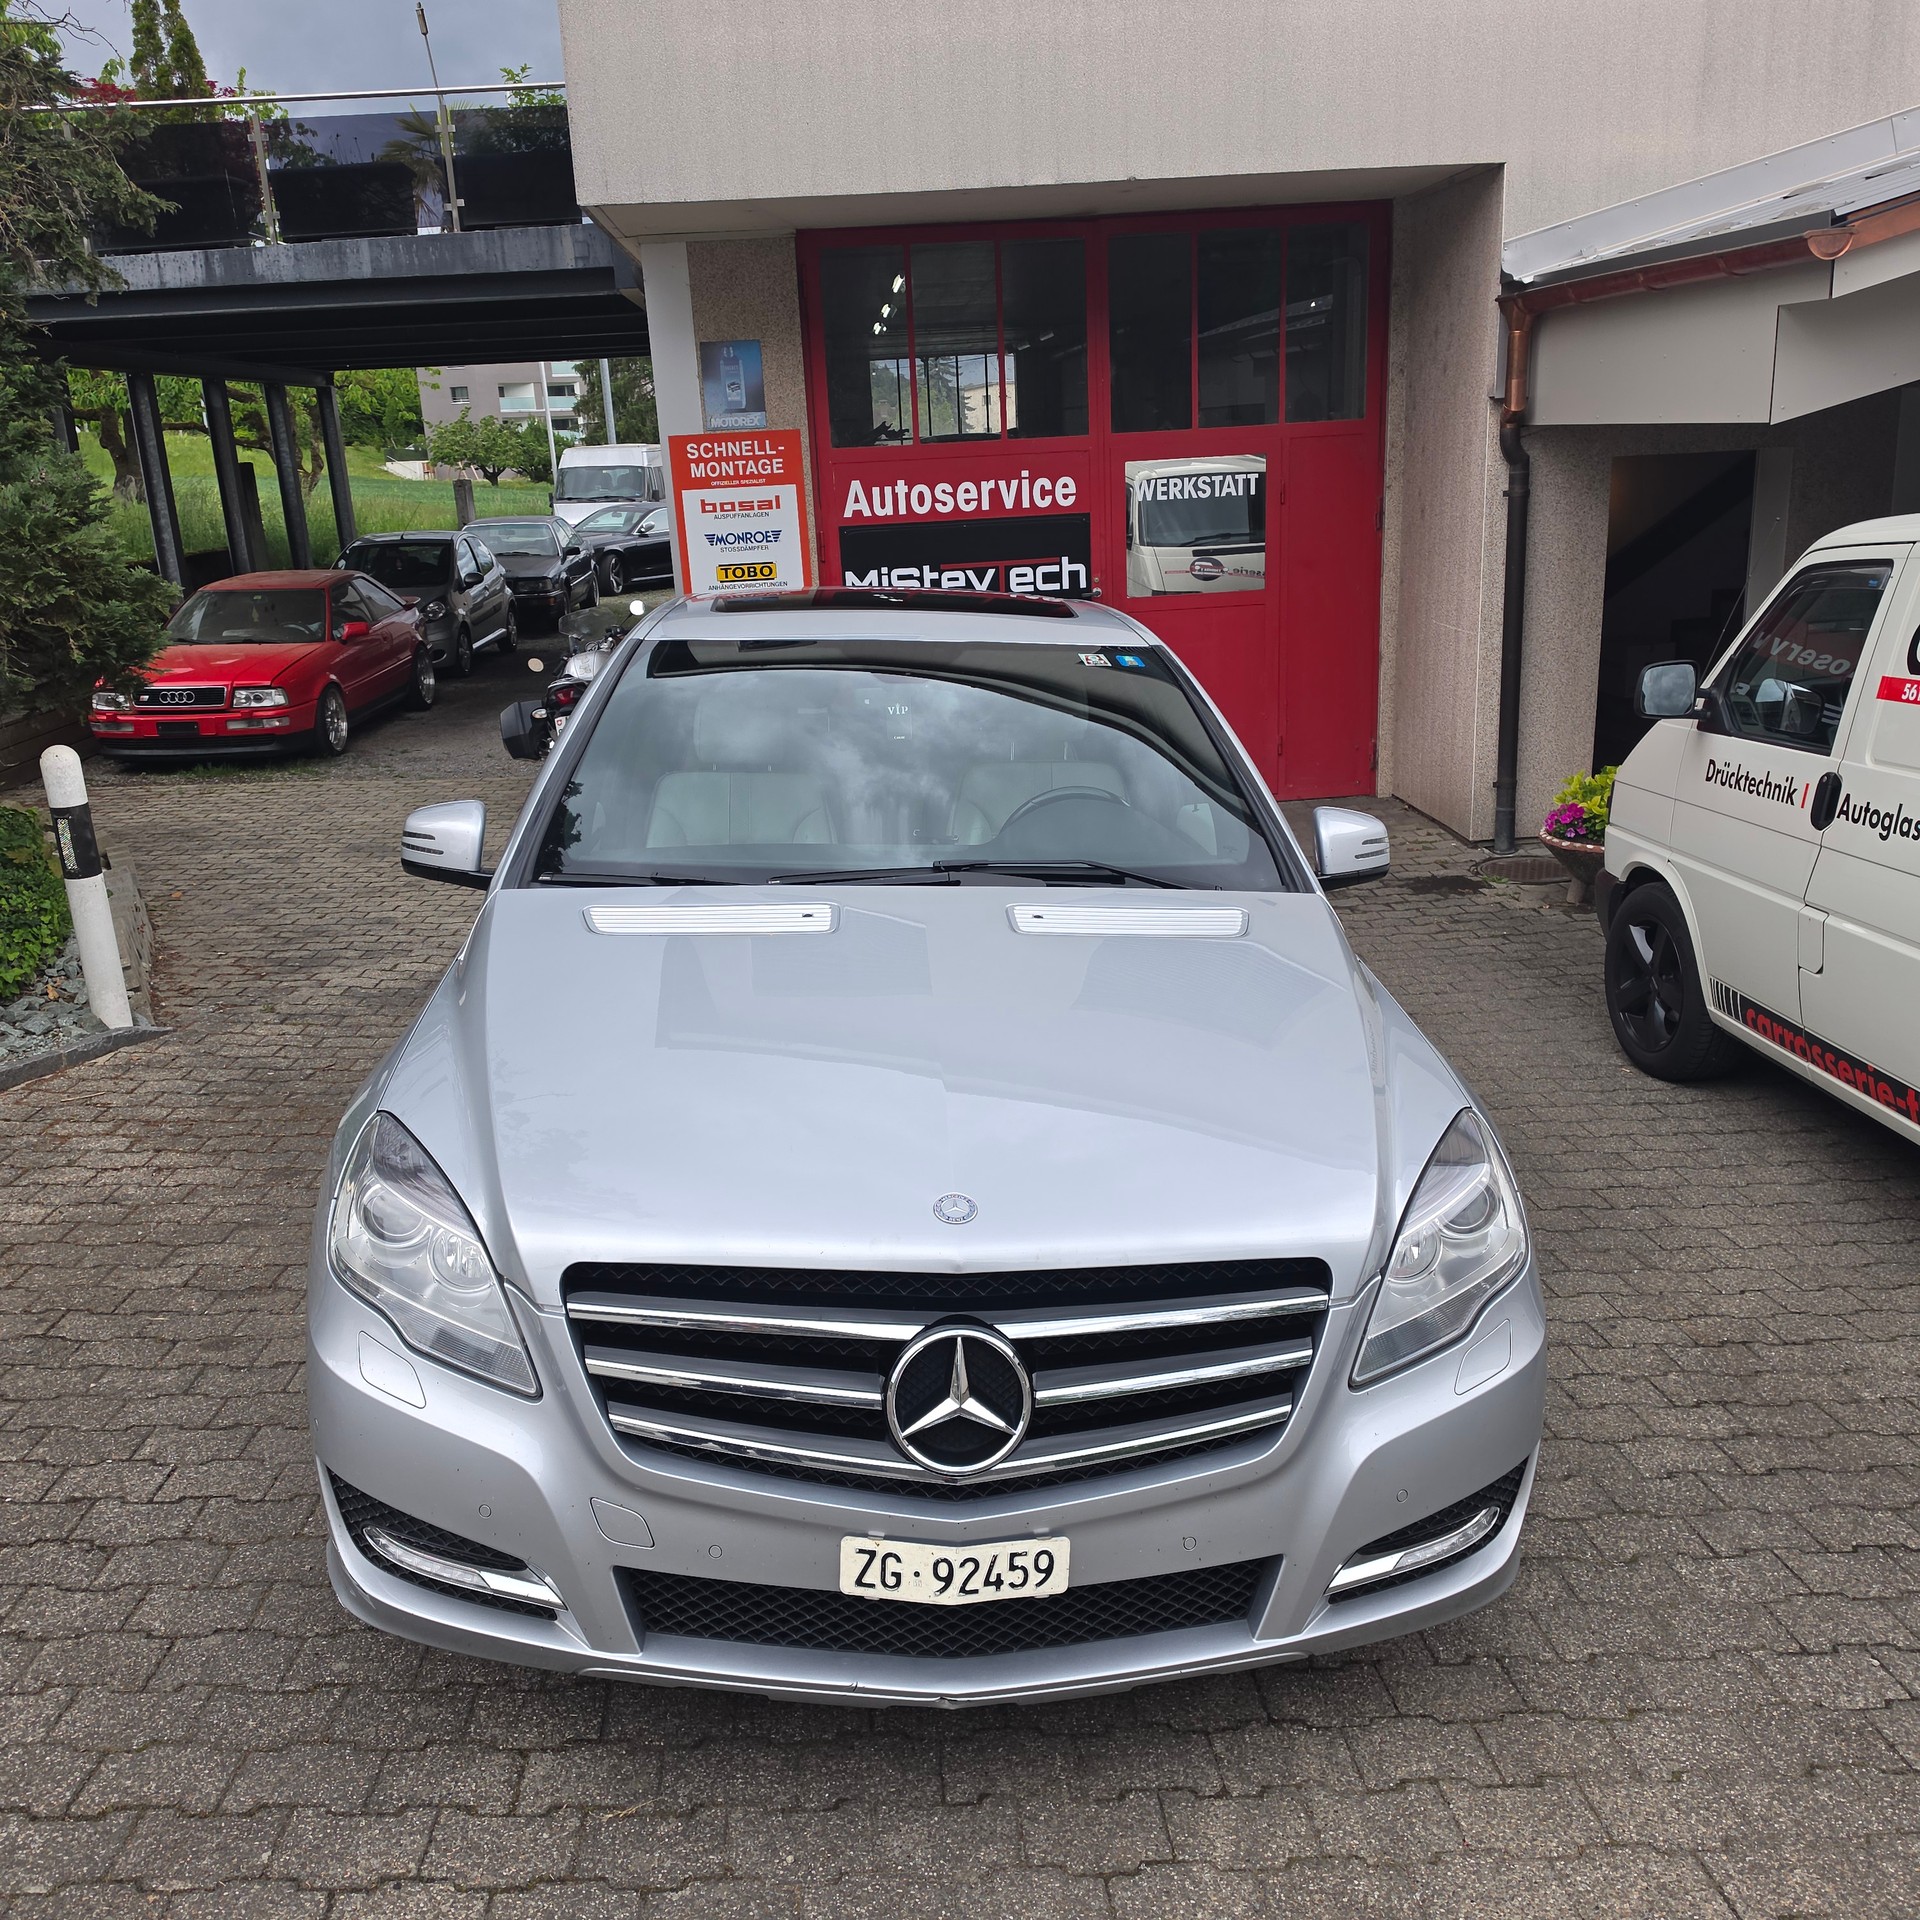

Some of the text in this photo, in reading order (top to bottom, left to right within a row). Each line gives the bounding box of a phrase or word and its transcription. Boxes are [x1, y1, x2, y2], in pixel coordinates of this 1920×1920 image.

[710, 415, 760, 428] MOTOREX
[686, 440, 785, 459] SCHNELL-
[690, 458, 784, 478] MONTAGE
[843, 470, 1077, 518] Autoservice
[1134, 473, 1259, 501] WERKSTATT
[700, 494, 780, 513] bosal
[714, 511, 769, 520] AUSPUFFANLAGEN
[715, 530, 773, 546] MONROE
[720, 545, 769, 553] STOSSDÄMPFER
[719, 565, 773, 579] TOBO
[708, 581, 788, 591] ANHÄNGEVORRICHTUNGEN
[1704, 758, 1798, 806] Drücktechnik
[854, 1548, 1055, 1597] ZG 92459
